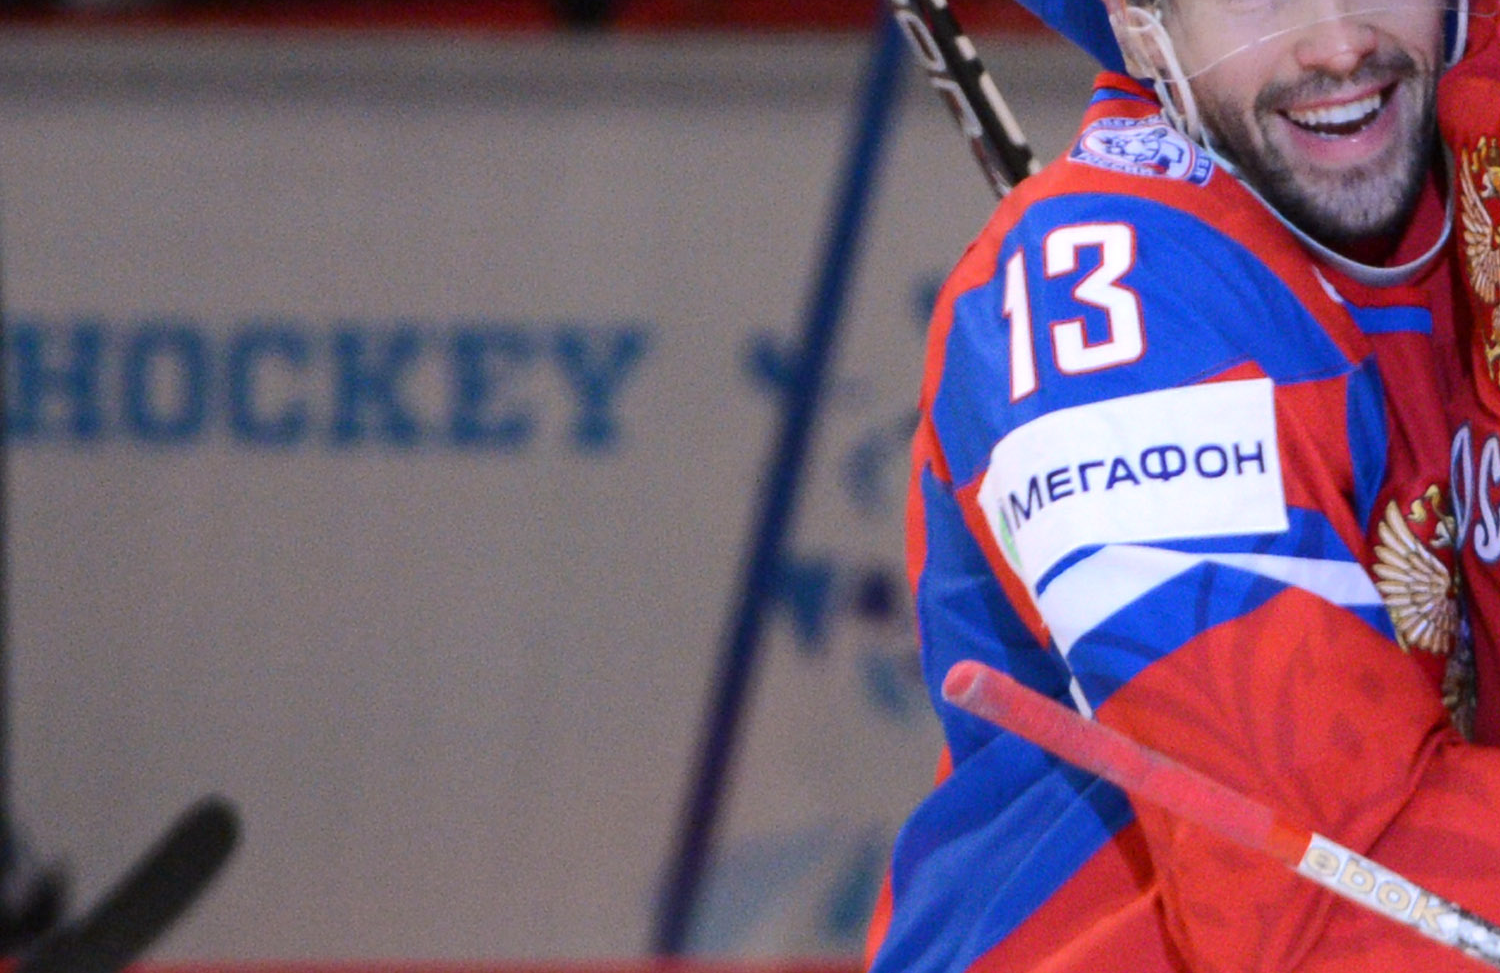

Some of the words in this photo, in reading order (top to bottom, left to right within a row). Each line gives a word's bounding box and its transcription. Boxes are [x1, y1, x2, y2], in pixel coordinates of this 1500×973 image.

[1002, 221, 1146, 404] 13
[2, 313, 648, 454] HOCKEY
[1007, 439, 1266, 531] МЕГАФОН
